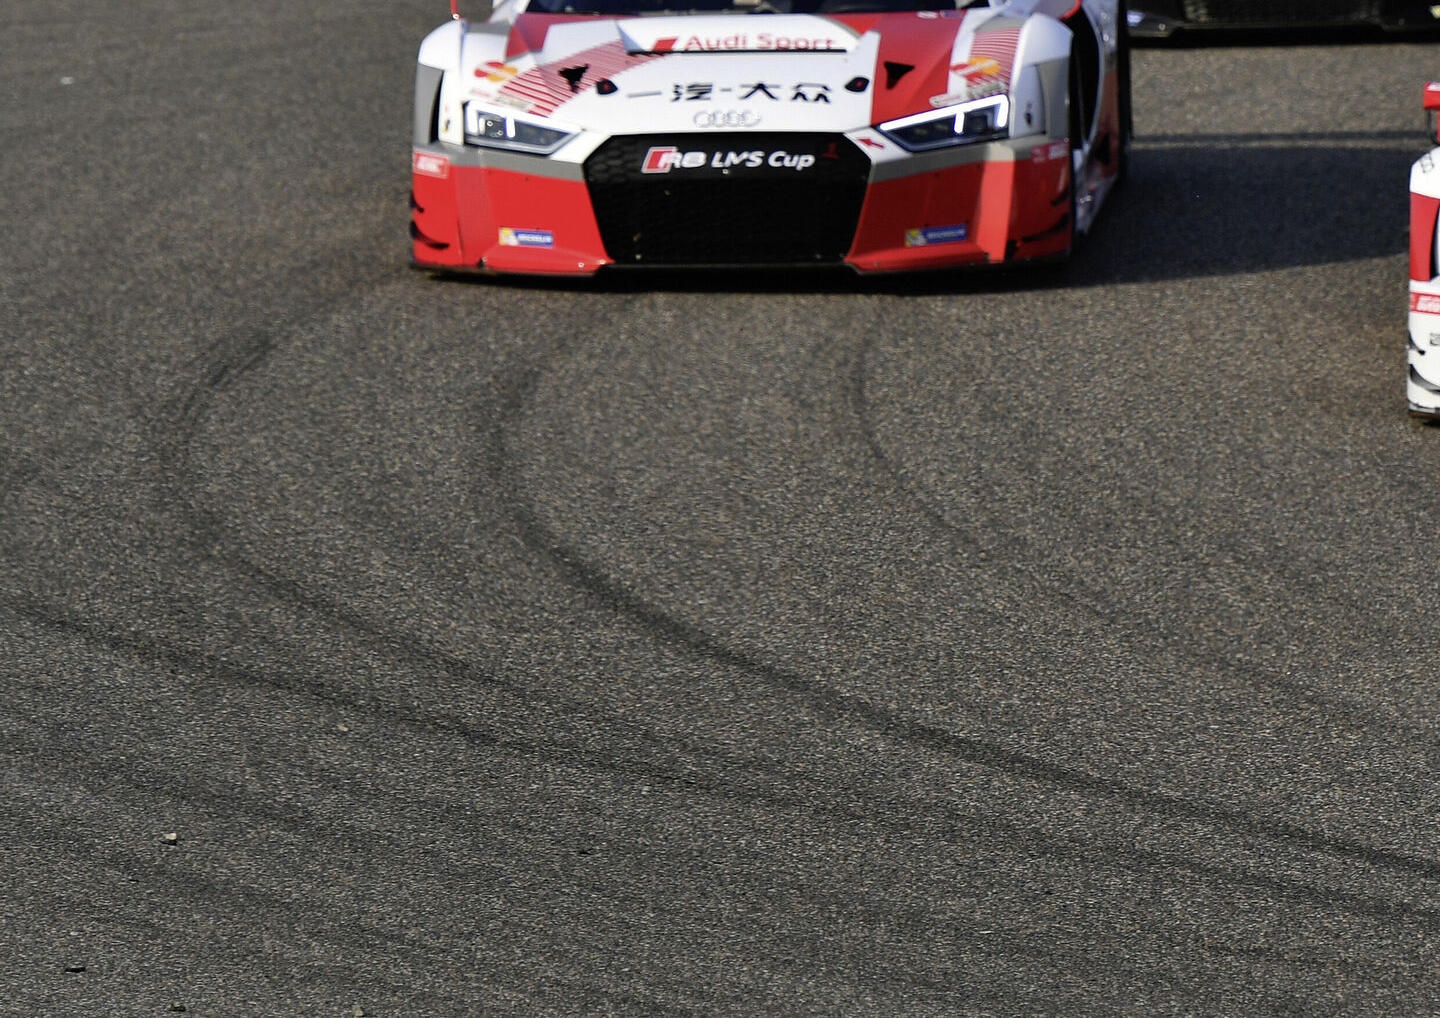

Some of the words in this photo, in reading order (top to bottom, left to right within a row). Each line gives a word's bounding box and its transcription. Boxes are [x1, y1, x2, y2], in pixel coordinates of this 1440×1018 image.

[684, 34, 748, 51] Audi
[756, 33, 835, 51] Sport
[710, 150, 765, 169] LMS
[768, 150, 816, 171] Cup
